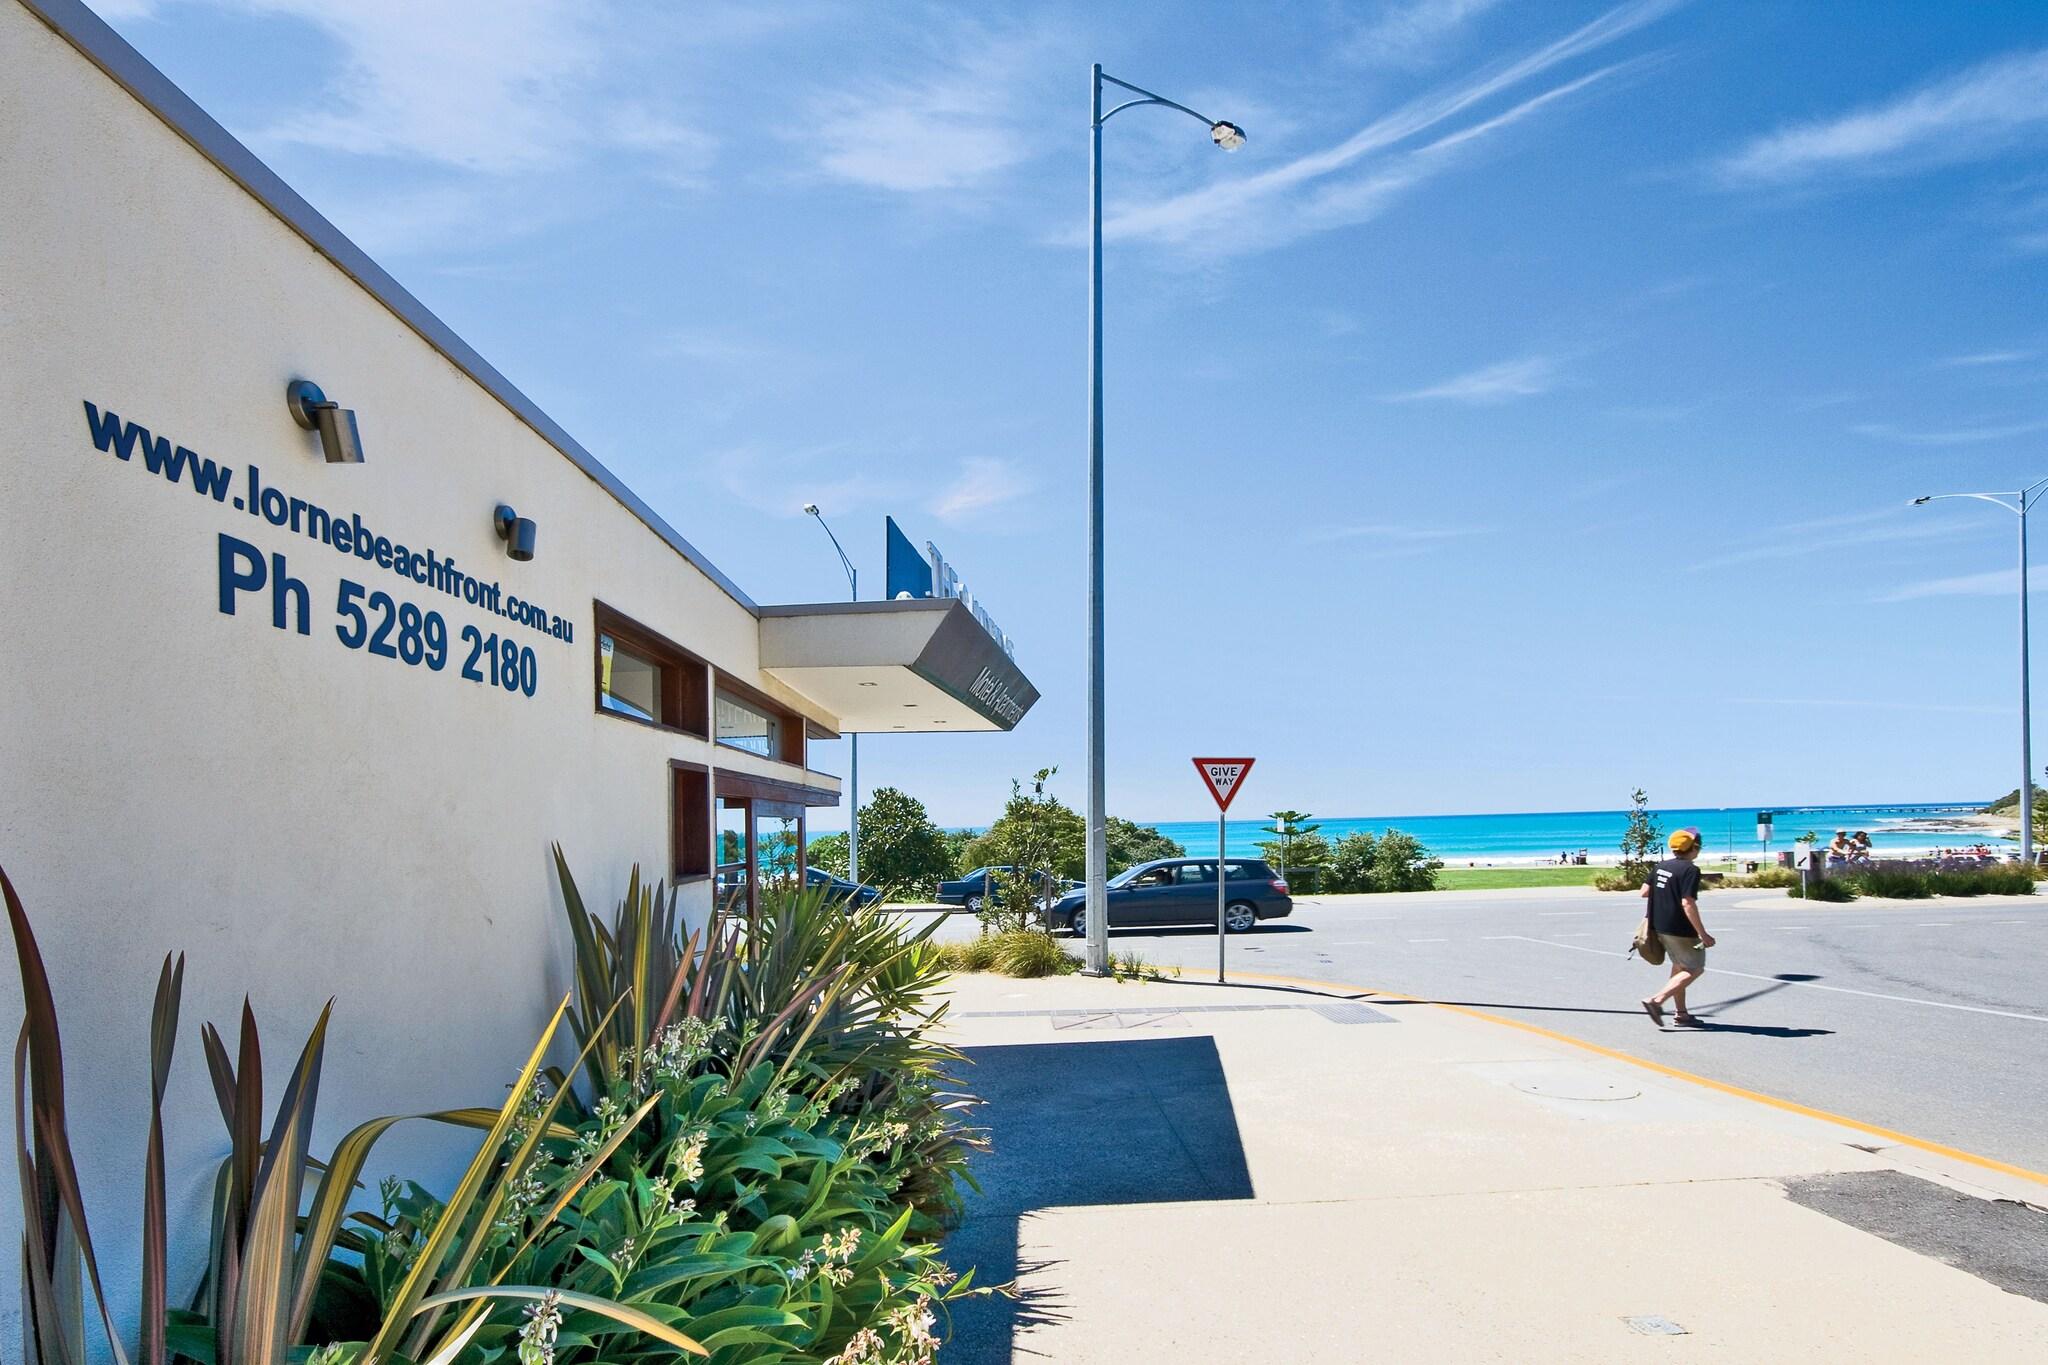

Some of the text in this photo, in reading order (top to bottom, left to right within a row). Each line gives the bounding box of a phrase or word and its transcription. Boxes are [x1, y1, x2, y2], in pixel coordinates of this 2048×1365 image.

[84, 400, 574, 645] www.lornebeachfront.com.au
[218, 532, 538, 699] Ph 5289 2180
[968, 666, 1000, 702] Motel
[1210, 767, 1238, 777] GIVE
[1215, 778, 1235, 786] WAY
